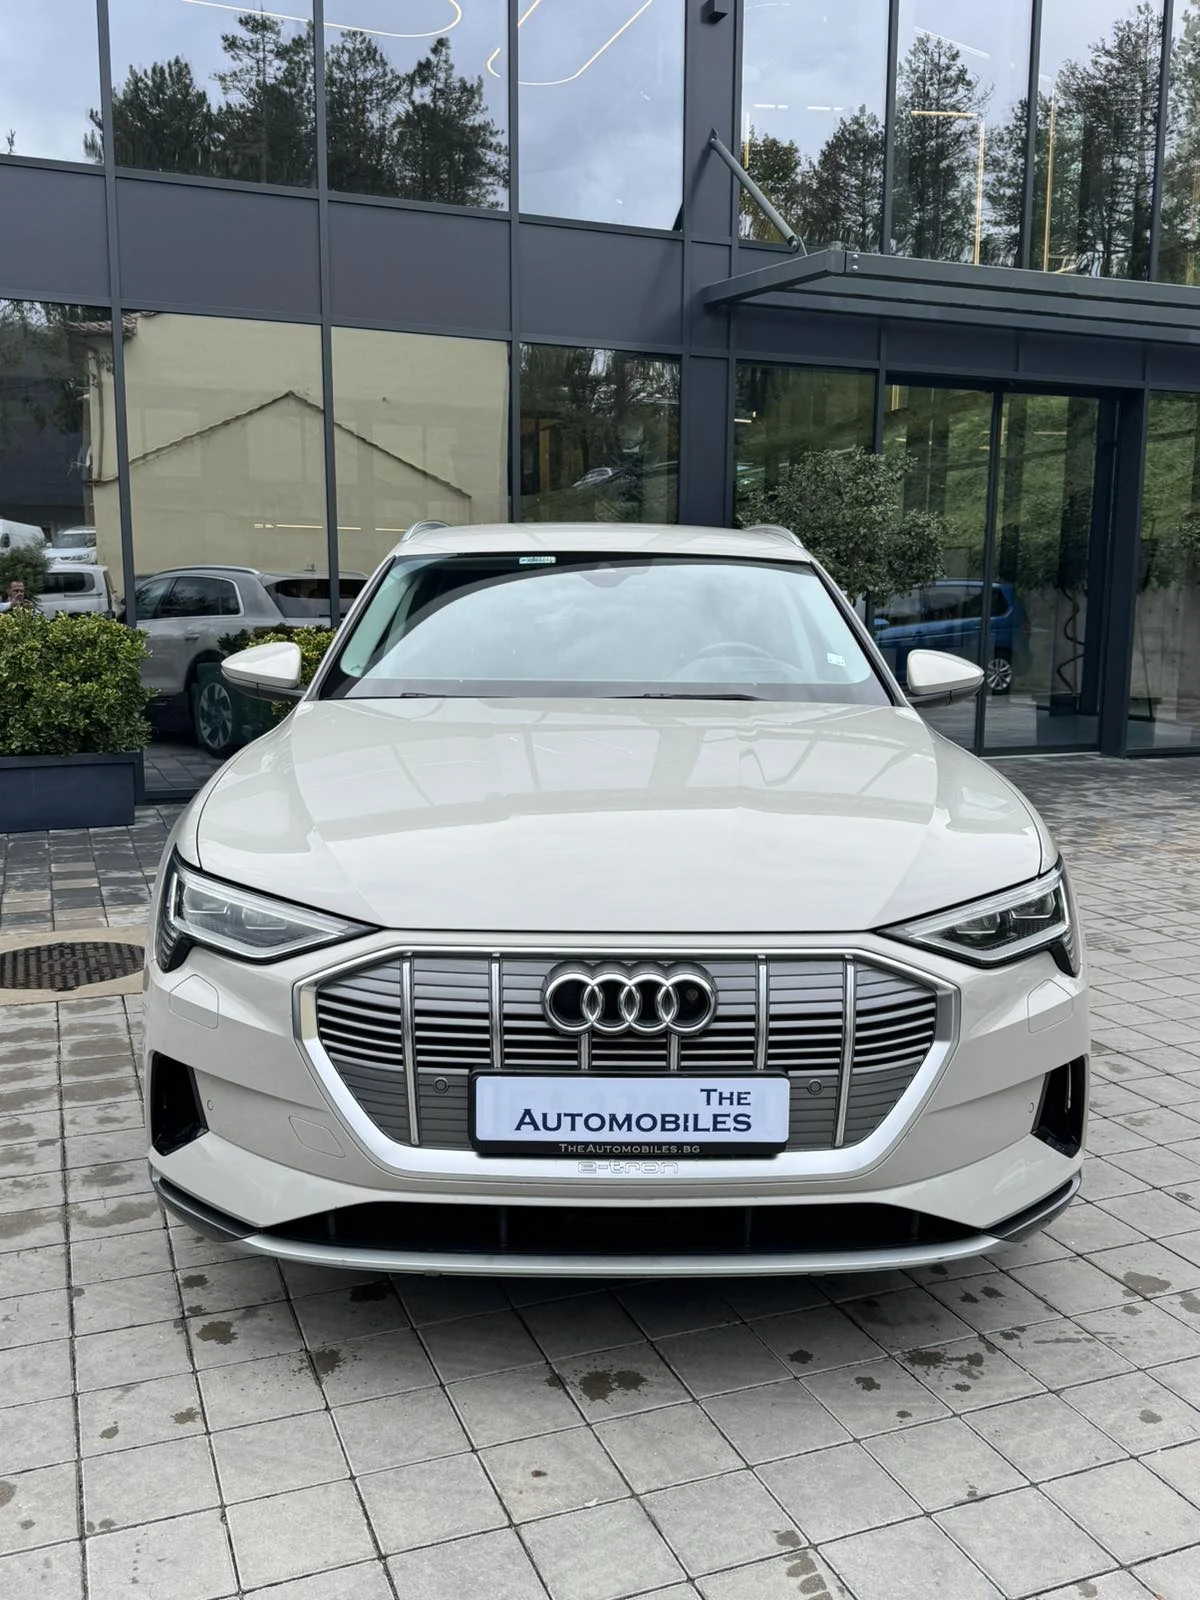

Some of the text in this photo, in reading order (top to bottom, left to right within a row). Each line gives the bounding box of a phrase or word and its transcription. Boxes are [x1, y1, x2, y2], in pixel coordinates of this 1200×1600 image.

[700, 1089, 752, 1106] THE
[514, 1108, 752, 1133] AUTOMOBILES
[577, 1159, 679, 1175] e-tron
